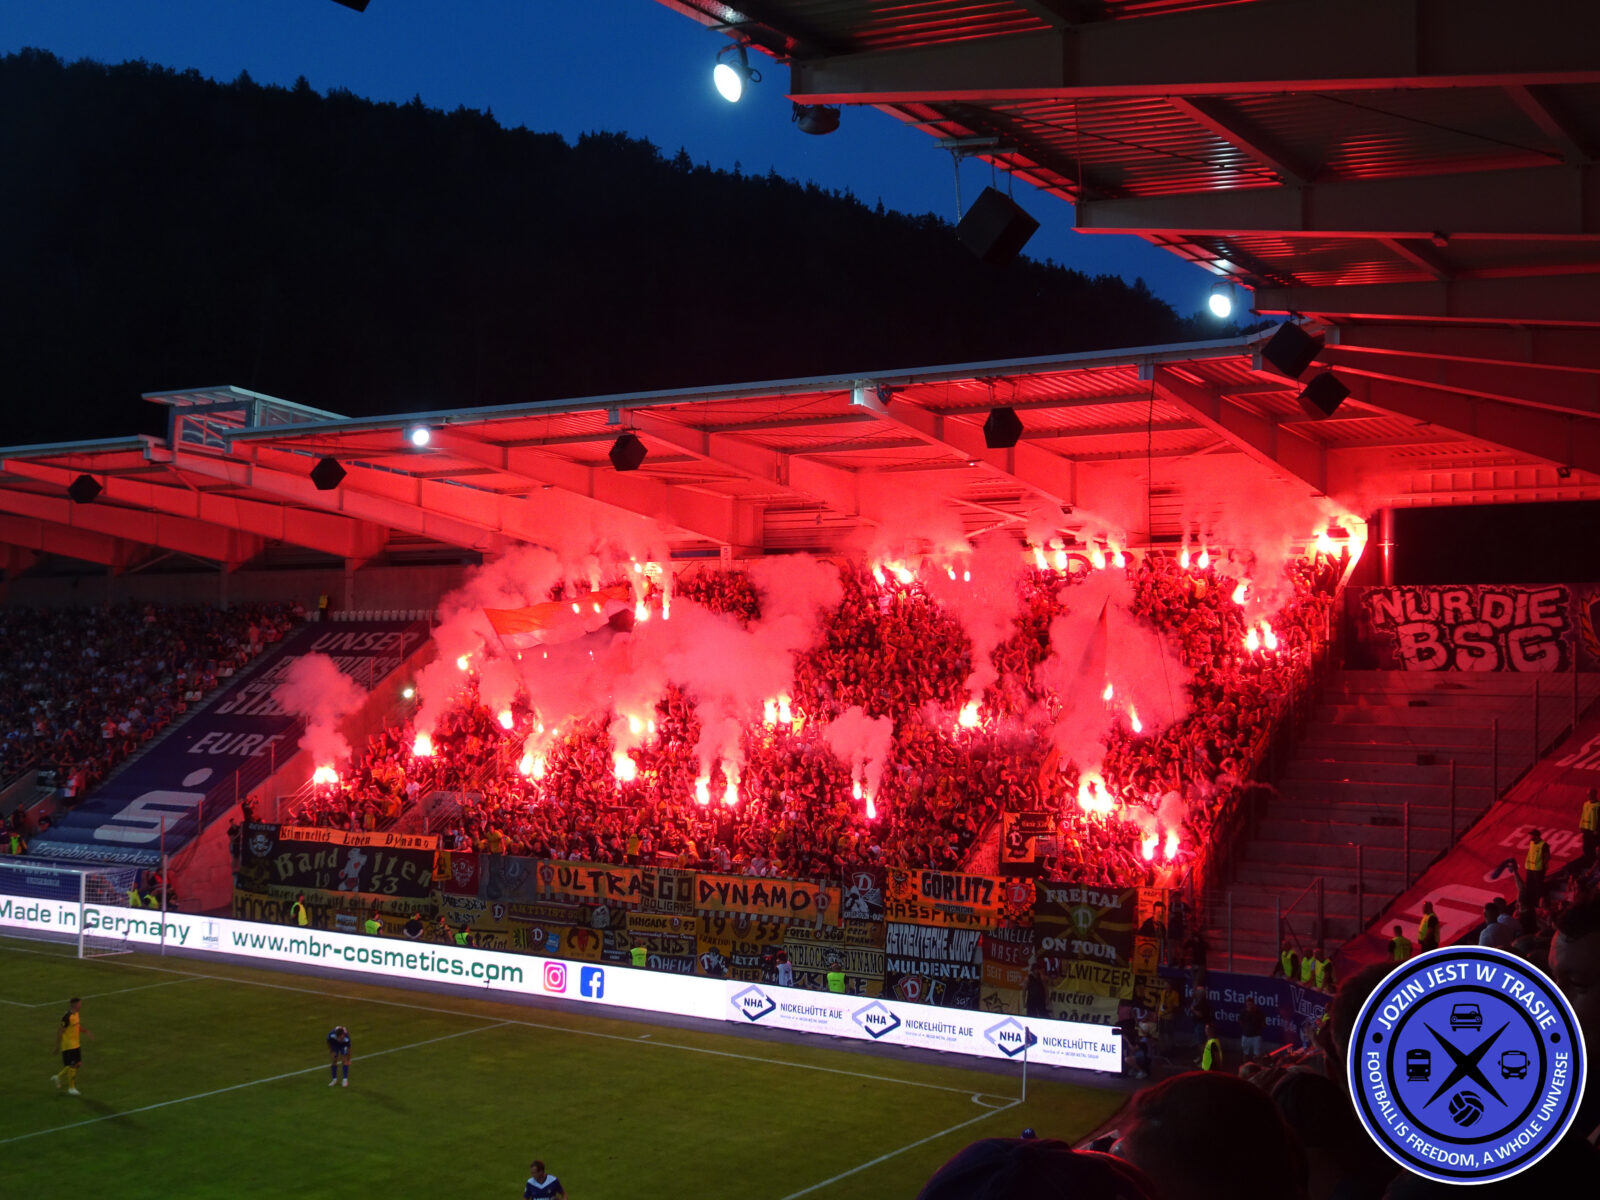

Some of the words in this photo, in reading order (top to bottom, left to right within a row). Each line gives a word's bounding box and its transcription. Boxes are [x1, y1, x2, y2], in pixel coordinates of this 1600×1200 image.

[1373, 590, 1476, 625] NUR
[1480, 589, 1564, 628] DIE
[310, 632, 420, 650] UNSER
[1400, 621, 1560, 672] BSG
[699, 879, 811, 911] DYNAMO
[921, 869, 994, 906] GÖRLITZ
[1045, 888, 1123, 909] FREITAL
[0, 900, 51, 923] Made
[58, 905, 76, 926] in
[83, 908, 191, 945] Germany
[232, 930, 524, 983] www.mbr-cosmetics.com
[887, 958, 981, 980] MULDENTAL
[743, 996, 764, 1009] NHA
[828, 1009, 844, 1020] AUE
[865, 1013, 887, 1026] NHA
[958, 1027, 974, 1037] AUE
[999, 1030, 1022, 1043] NHA
[1100, 1043, 1117, 1054] AUE
